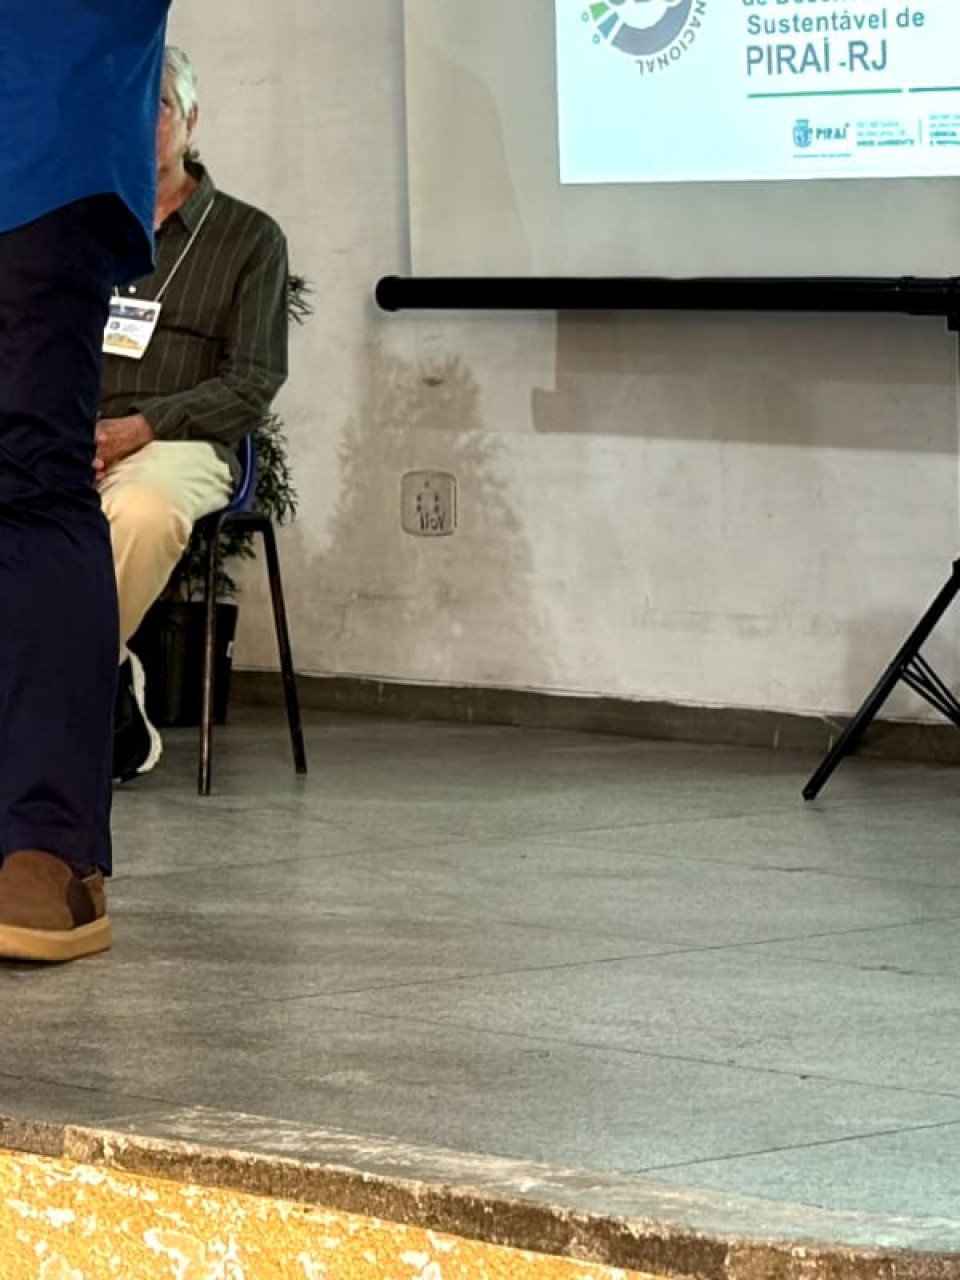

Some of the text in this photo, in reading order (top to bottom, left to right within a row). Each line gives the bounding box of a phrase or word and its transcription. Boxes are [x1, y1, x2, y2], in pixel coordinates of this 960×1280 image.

[635, 0, 707, 75] NACIONAL
[747, 7, 925, 35] Sustentável de
[746, 37, 830, 76] PIRAÍ
